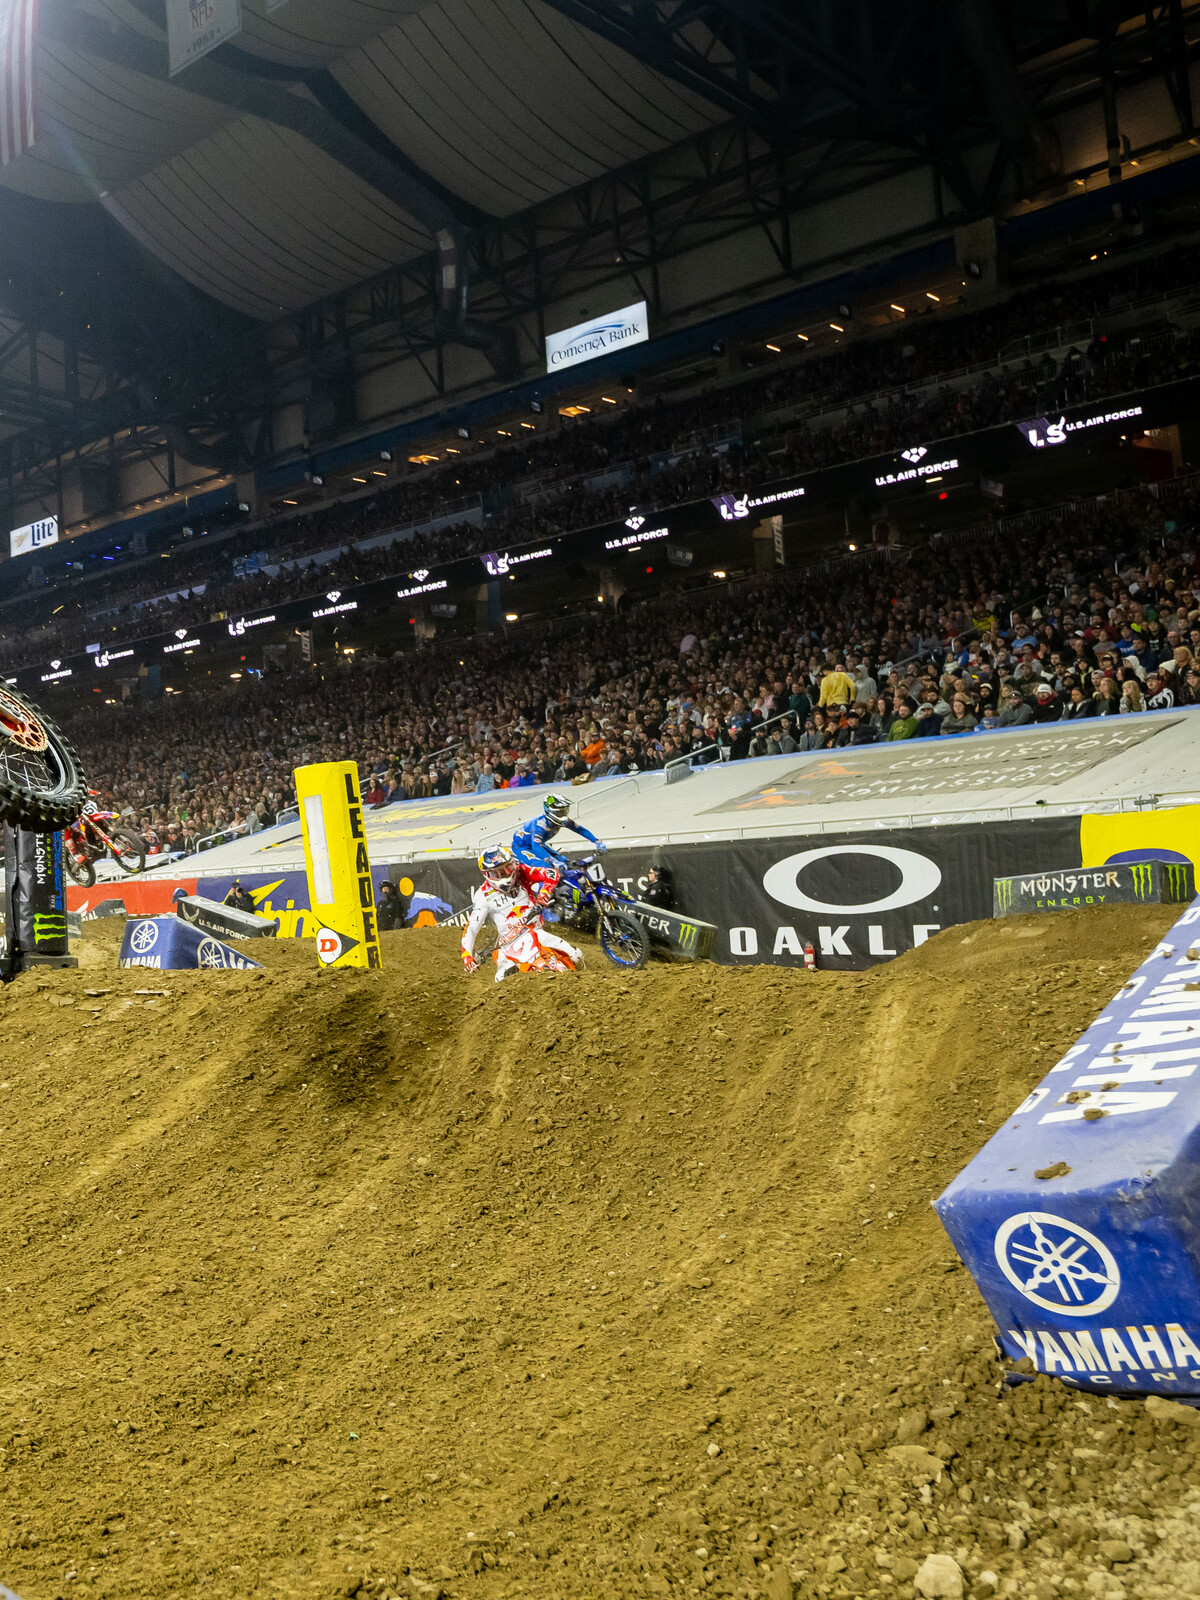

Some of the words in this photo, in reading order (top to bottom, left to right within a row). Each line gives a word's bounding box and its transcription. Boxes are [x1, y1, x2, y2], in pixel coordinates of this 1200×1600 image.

[609, 323, 640, 343] Bank
[1066, 420, 1085, 431] U.S.
[1085, 415, 1104, 427] AIR
[1105, 407, 1142, 423] FORCE
[875, 473, 897, 486] U.S.
[897, 469, 917, 481] AIR
[918, 459, 959, 477] FORCE
[747, 499, 762, 507] U.S.
[762, 494, 776, 504] AIR
[776, 488, 805, 501] FORCE
[30, 521, 54, 546] Lite
[605, 539, 622, 549] U.S.
[622, 534, 637, 545] AIR
[638, 528, 669, 543] FORCE
[531, 549, 552, 559] FORCE
[397, 588, 411, 598] U.S.
[411, 585, 423, 595] AIR
[423, 580, 447, 593] FORCE
[325, 605, 336, 615] AIR
[336, 601, 358, 612] FORCE
[888, 736, 1136, 770] COMMISSION
[825, 769, 1072, 798] COMMISSION
[34, 832, 47, 884] MONSTE
[345, 774, 379, 968] LEADER
[592, 865, 600, 879] 1
[1019, 871, 1122, 897] MONSTER
[1037, 895, 1107, 908] ENERGY
[212, 923, 225, 933] AIR
[1007, 1323, 1200, 1372] YAMAHA
